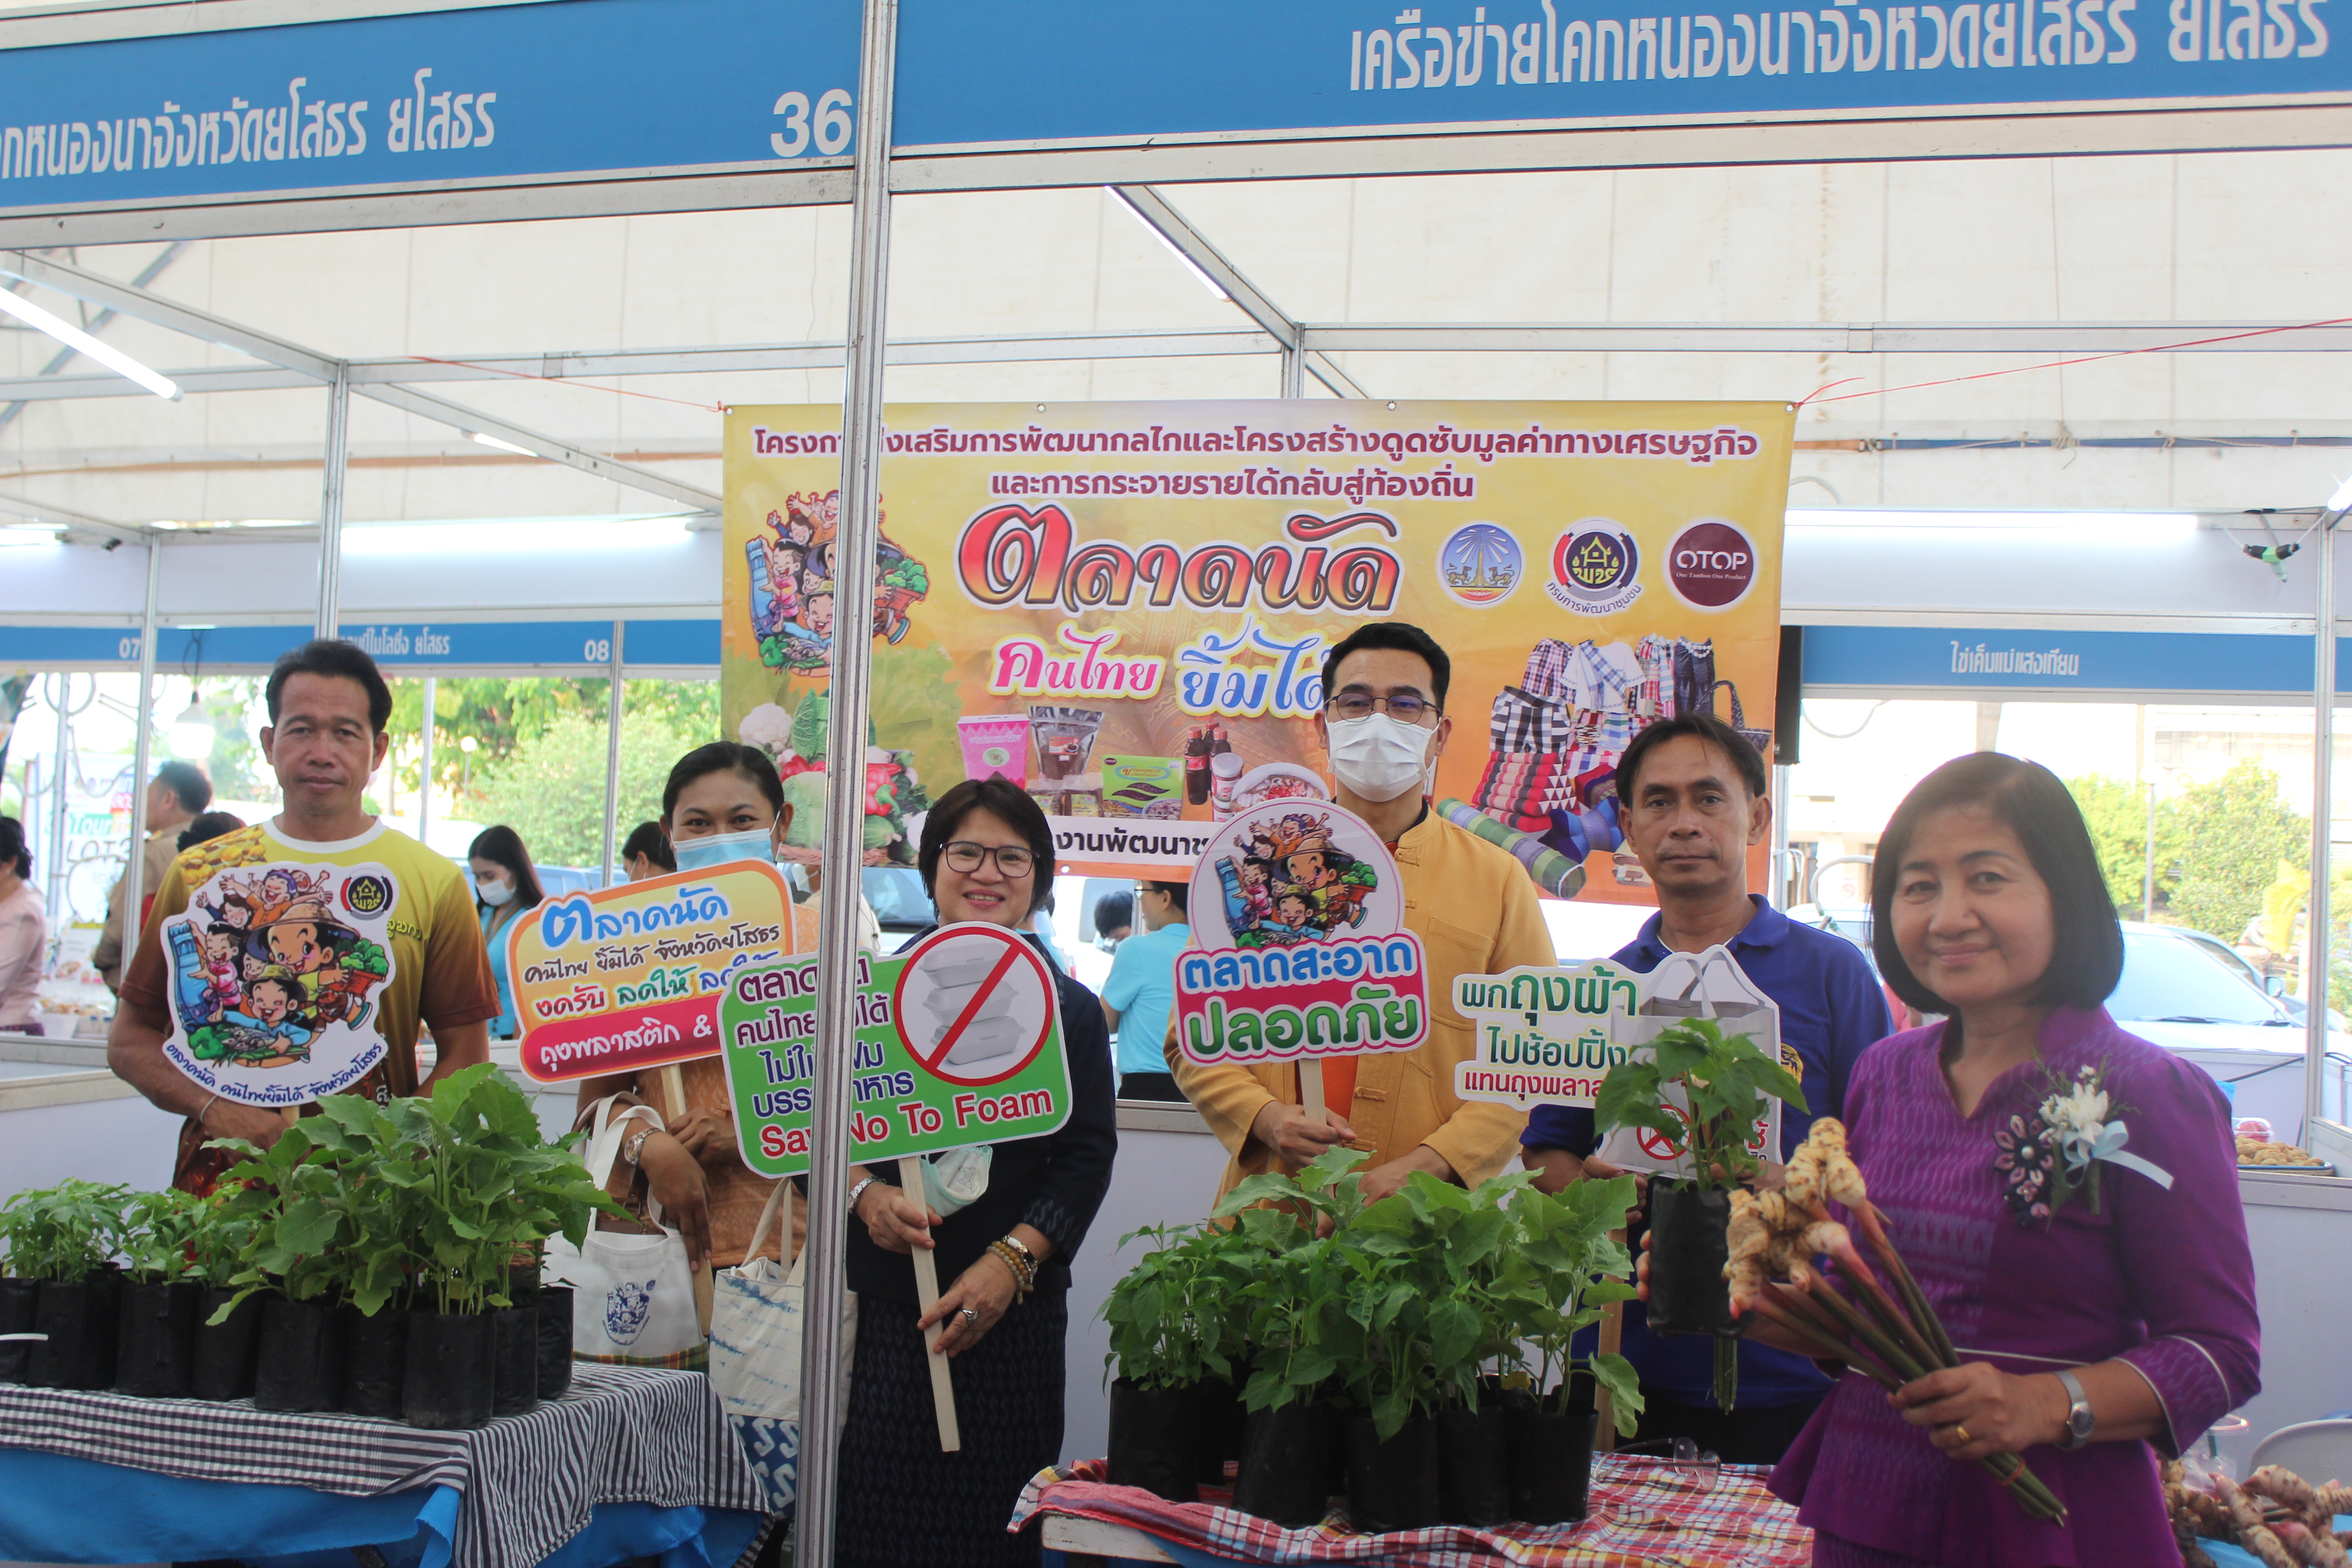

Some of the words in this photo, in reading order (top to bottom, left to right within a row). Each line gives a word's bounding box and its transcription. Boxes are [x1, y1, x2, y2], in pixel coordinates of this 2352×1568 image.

[0, 78, 368, 179] กหนองนาจังหวัดยโสธร
[388, 68, 496, 153] ยโสธร
[770, 88, 853, 157] 36
[992, 464, 1473, 505] และการกระจายรายได้กลับสู่ท้องถิ่น
[959, 504, 1399, 612] ตลาดนัด
[1676, 550, 1747, 570] OTOP
[1547, 582, 1642, 614] กรมการพัฒนาชุมชน
[118, 637, 141, 659] 07
[415, 626, 450, 655] ยโสธร
[584, 639, 609, 662] 08
[994, 627, 1159, 691] คนไทย
[1055, 827, 1210, 856] งานพัฒนาช
[541, 887, 728, 948] ตลาดนัด
[524, 959, 588, 984] คนไทย
[596, 945, 651, 971] ยิ้มได้
[654, 923, 780, 962] จังหวัดยโสธร
[1185, 942, 1412, 989] ตลาดสะอาด
[536, 985, 606, 1017] งดรับ
[617, 965, 697, 1004] ลดให้
[1462, 966, 1637, 1026] พกถุงผ้า
[540, 1017, 680, 1072] ถุงพลาสติก
[692, 1014, 713, 1038] &
[1190, 987, 1418, 1055] ปลอดภัย
[166, 1044, 216, 1087] ตลาดนัด
[220, 1083, 308, 1102] คนไทยยิ้มได้
[308, 1043, 382, 1095] จังหวัดยโสธร
[1486, 1026, 1627, 1069] ไปช้อปปิ้ง
[899, 1103, 941, 1134] To
[955, 1090, 1052, 1127] Foam
